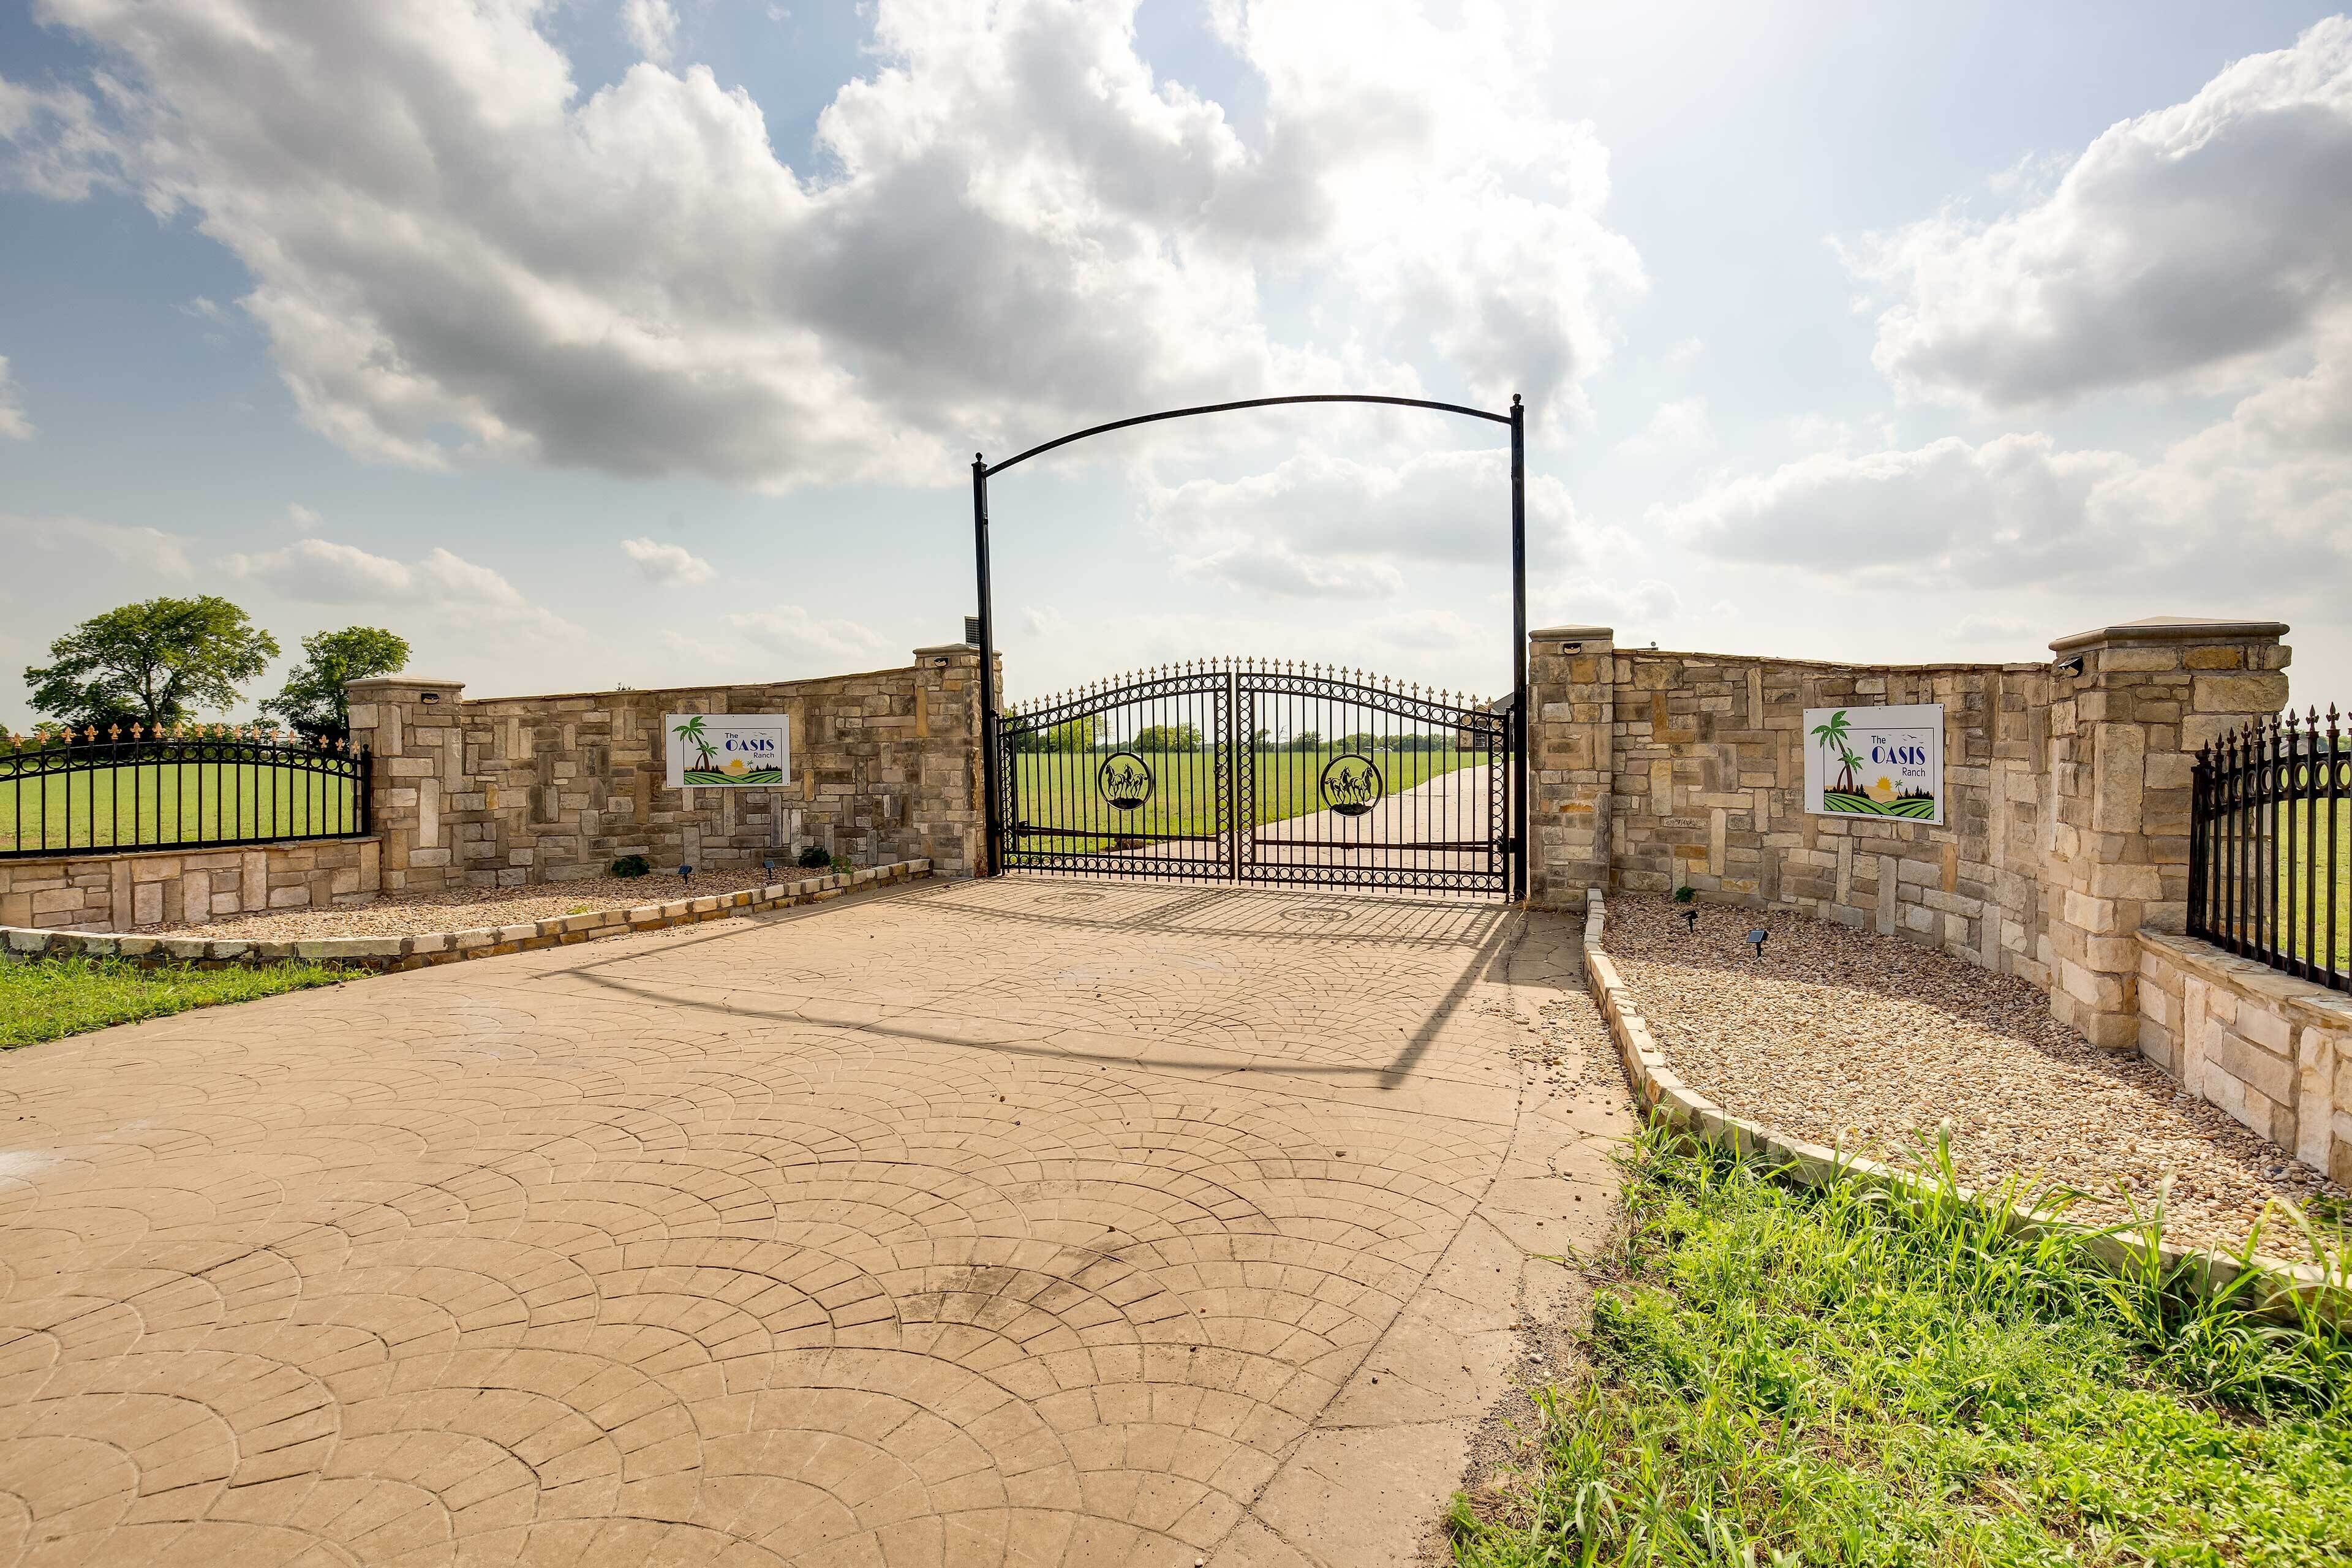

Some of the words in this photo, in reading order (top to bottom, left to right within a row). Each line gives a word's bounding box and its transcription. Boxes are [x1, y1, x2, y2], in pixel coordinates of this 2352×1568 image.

[1871, 735, 1886, 744] The
[725, 739, 774, 752] OASIS
[1872, 745, 1925, 765] OASIS
[1902, 767, 1926, 777] Ranch
